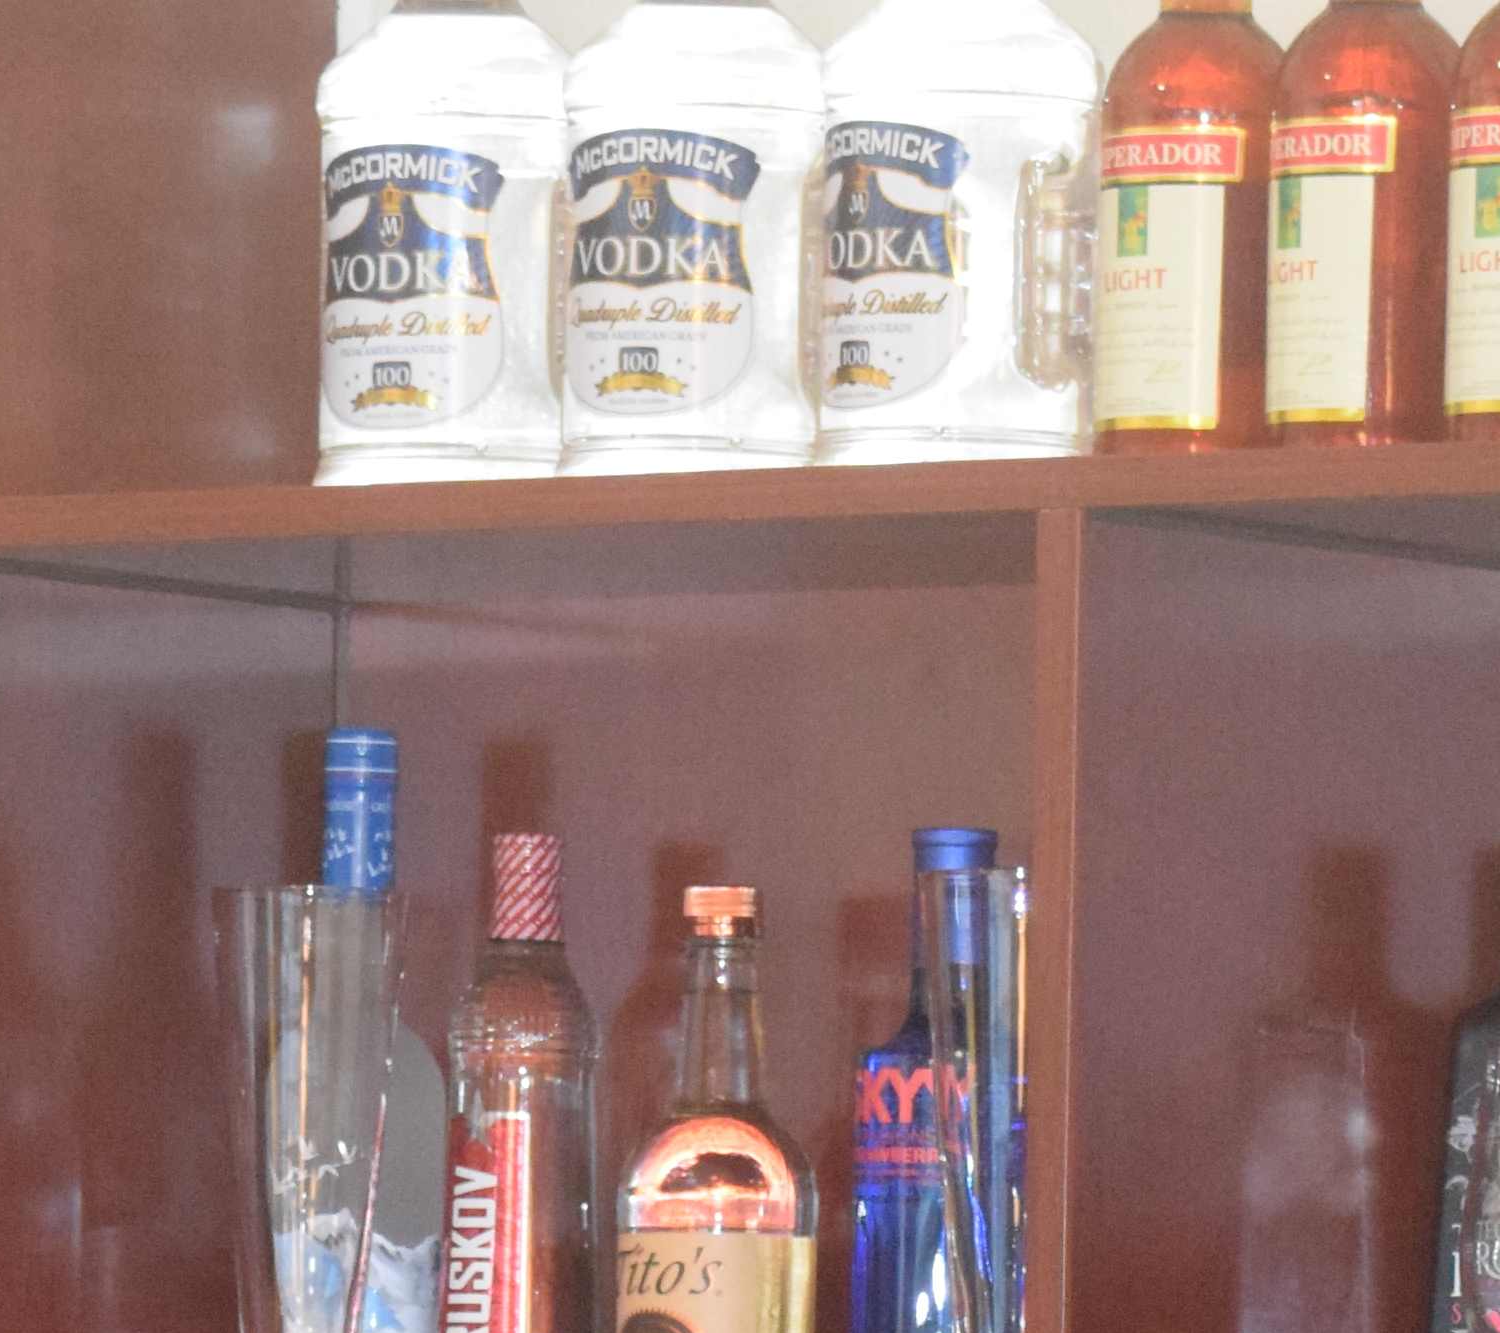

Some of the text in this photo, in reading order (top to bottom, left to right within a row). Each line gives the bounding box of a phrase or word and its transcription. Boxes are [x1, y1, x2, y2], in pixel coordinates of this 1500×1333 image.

[576, 136, 738, 181] McCORMICK
[827, 128, 944, 168] CORMICK
[328, 153, 484, 196] McCORMICK
[330, 252, 485, 294] VODKA
[577, 236, 728, 276] VODKA
[373, 366, 411, 387] 100
[621, 351, 658, 372] 100
